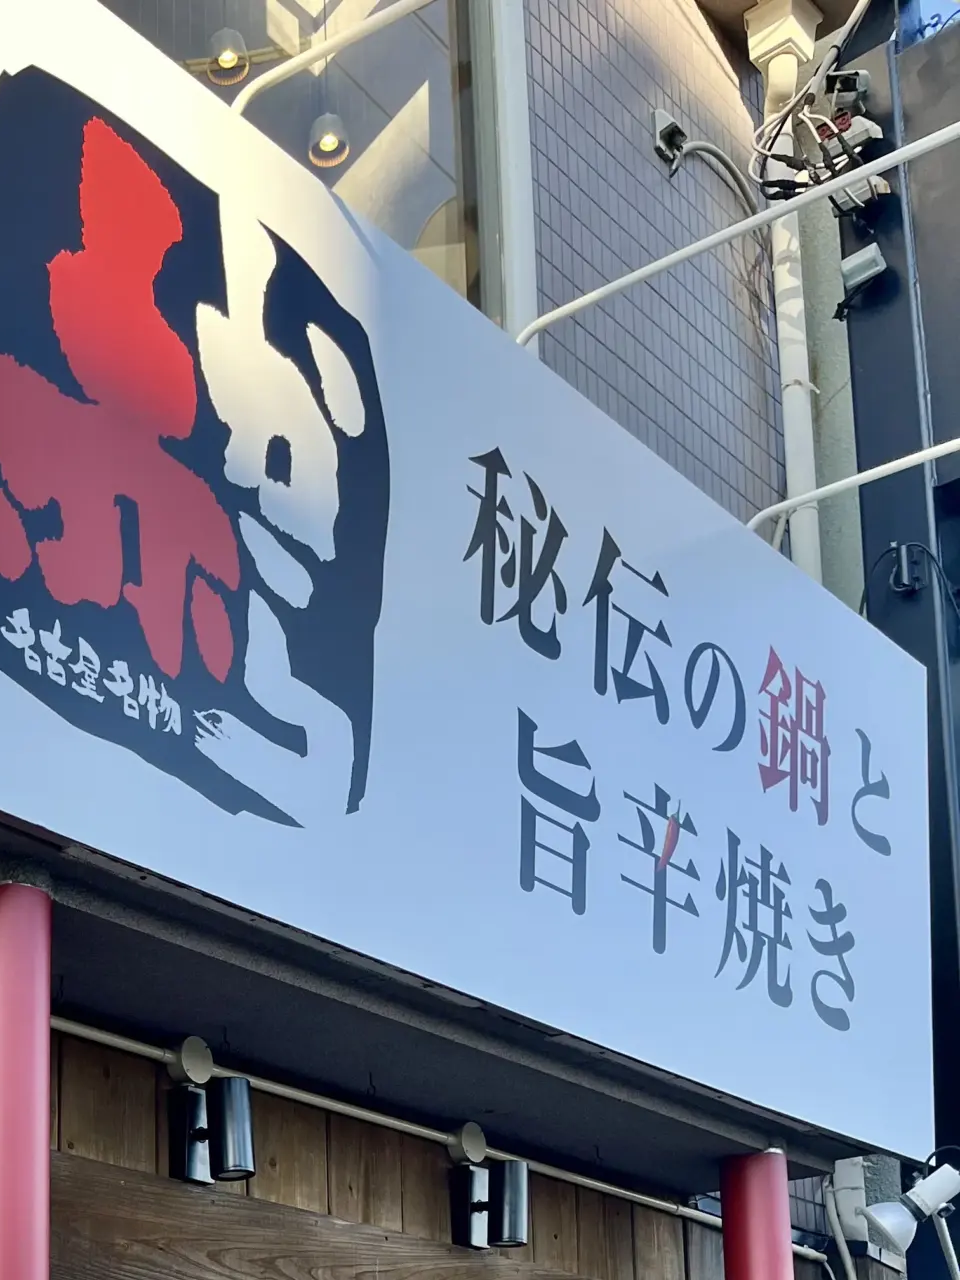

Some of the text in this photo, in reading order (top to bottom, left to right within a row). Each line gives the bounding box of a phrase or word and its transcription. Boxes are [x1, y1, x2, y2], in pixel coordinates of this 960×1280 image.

[0, 608, 182, 735] 名古屋名物
[463, 446, 891, 856] 秘伝の鍋と
[517, 706, 856, 1031] 旨辛焼き
